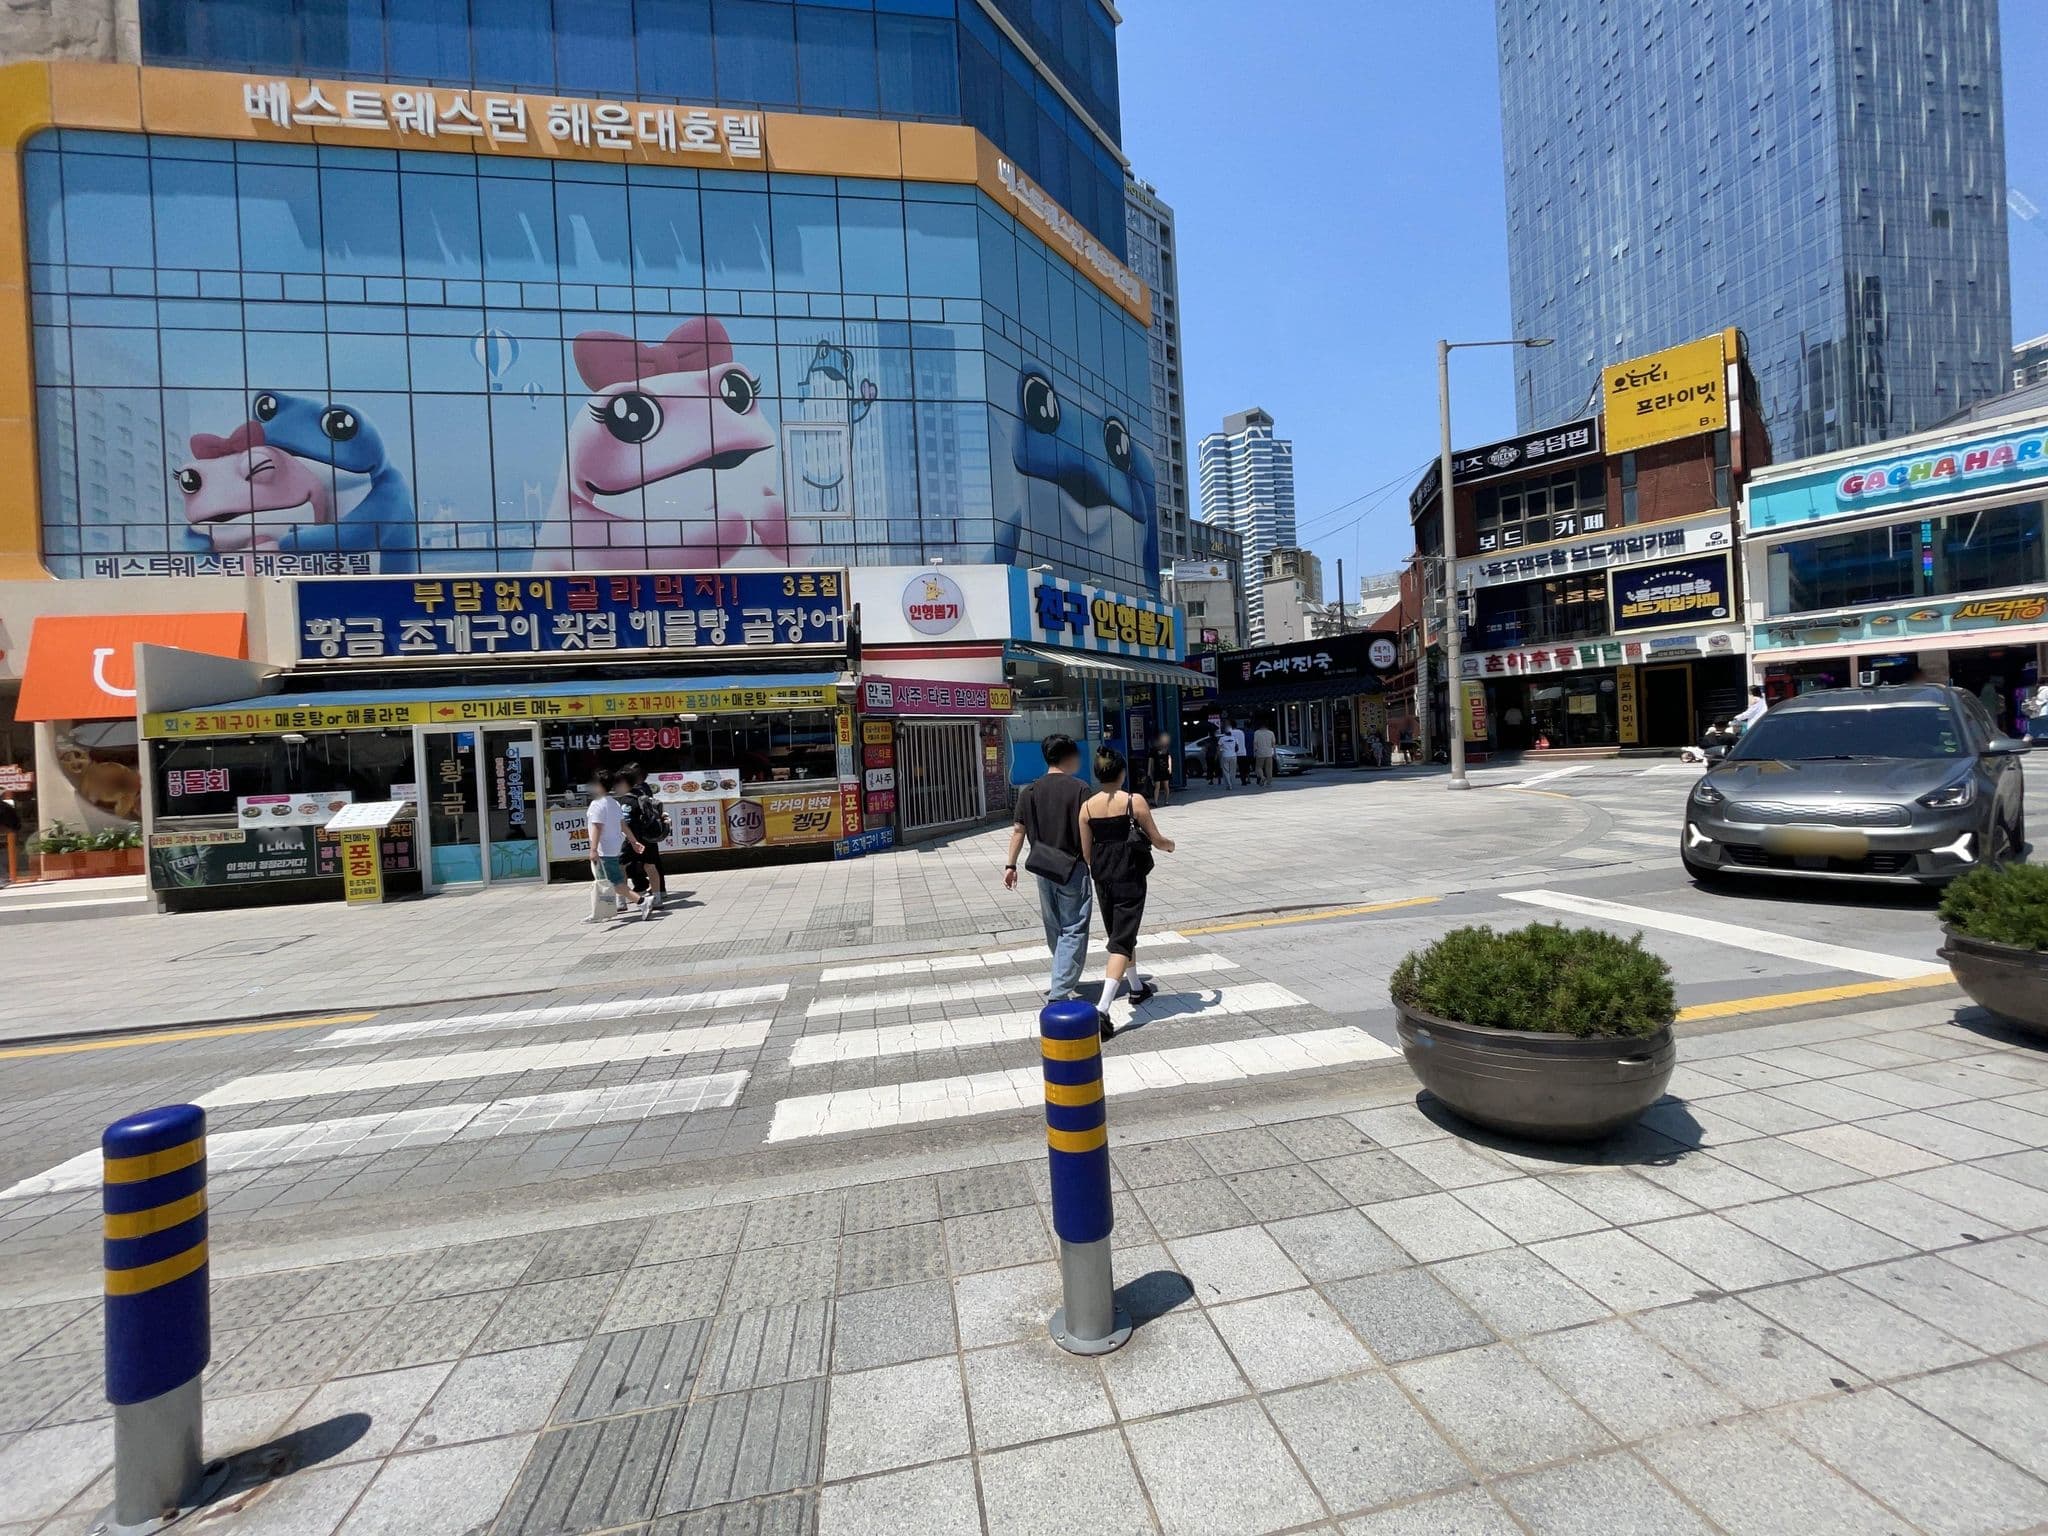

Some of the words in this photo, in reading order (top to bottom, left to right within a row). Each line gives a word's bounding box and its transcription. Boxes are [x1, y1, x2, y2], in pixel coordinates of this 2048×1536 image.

[243, 81, 528, 144] 베스트웨스턴
[546, 101, 763, 159] 해운대호텔
[1612, 363, 1668, 394] 오티티
[1636, 381, 1716, 417] 프라이빗
[1526, 427, 1589, 459] 홀덤펍
[1843, 457, 1956, 495] GACHA
[1479, 529, 1522, 550] 보드
[1555, 513, 1604, 535] 카페
[1570, 528, 1685, 564] 보드게임카페
[95, 555, 244, 579] 베스트웨스턴
[254, 553, 371, 576] 해운대호텔
[414, 579, 553, 613] 부담없이
[567, 575, 738, 611] 골라먹자!
[783, 575, 837, 597] 3호점
[1622, 592, 1719, 617] 보드게임카페
[909, 604, 958, 620] 인형뽑기
[1034, 584, 1090, 636] 친구
[1091, 598, 1174, 649] 인형뽑기
[1953, 597, 2047, 621] 사격장
[305, 617, 385, 658] 황금
[399, 613, 541, 653] 조개구이
[552, 611, 616, 650] 횟집
[629, 607, 729, 647] 해물탕
[742, 606, 840, 645] 곰장어
[1484, 647, 1576, 673] 춘하추동
[1579, 642, 1621, 661] 밀면
[627, 695, 675, 710] 조개구이
[686, 694, 720, 709] 곰장어
[732, 691, 767, 706] 매운탕
[867, 683, 891, 699] 한국
[898, 687, 951, 707] 사주·타로
[194, 713, 260, 731] 조개구이
[275, 711, 323, 727] 매운탕
[326, 714, 342, 724] or
[346, 706, 409, 724] 해물라면
[461, 699, 527, 718] 인기세트
[531, 700, 561, 715] 메뉴
[550, 737, 600, 749] 국내산
[608, 727, 681, 751] 곰장어
[184, 769, 230, 793] 물회
[440, 759, 465, 816] 황금
[876, 775, 893, 785] 사주
[681, 806, 716, 816] 조개구이
[770, 799, 804, 811] 라거의
[808, 796, 832, 808] 반전
[845, 794, 859, 832] 포장
[555, 818, 585, 831] 여기가
[729, 811, 761, 829] Kelly
[793, 811, 831, 831] 켈리
[343, 834, 371, 842] 전메뉴
[570, 841, 591, 851] 먹고
[852, 834, 879, 851] 조개구이
[349, 844, 373, 876] 포장
